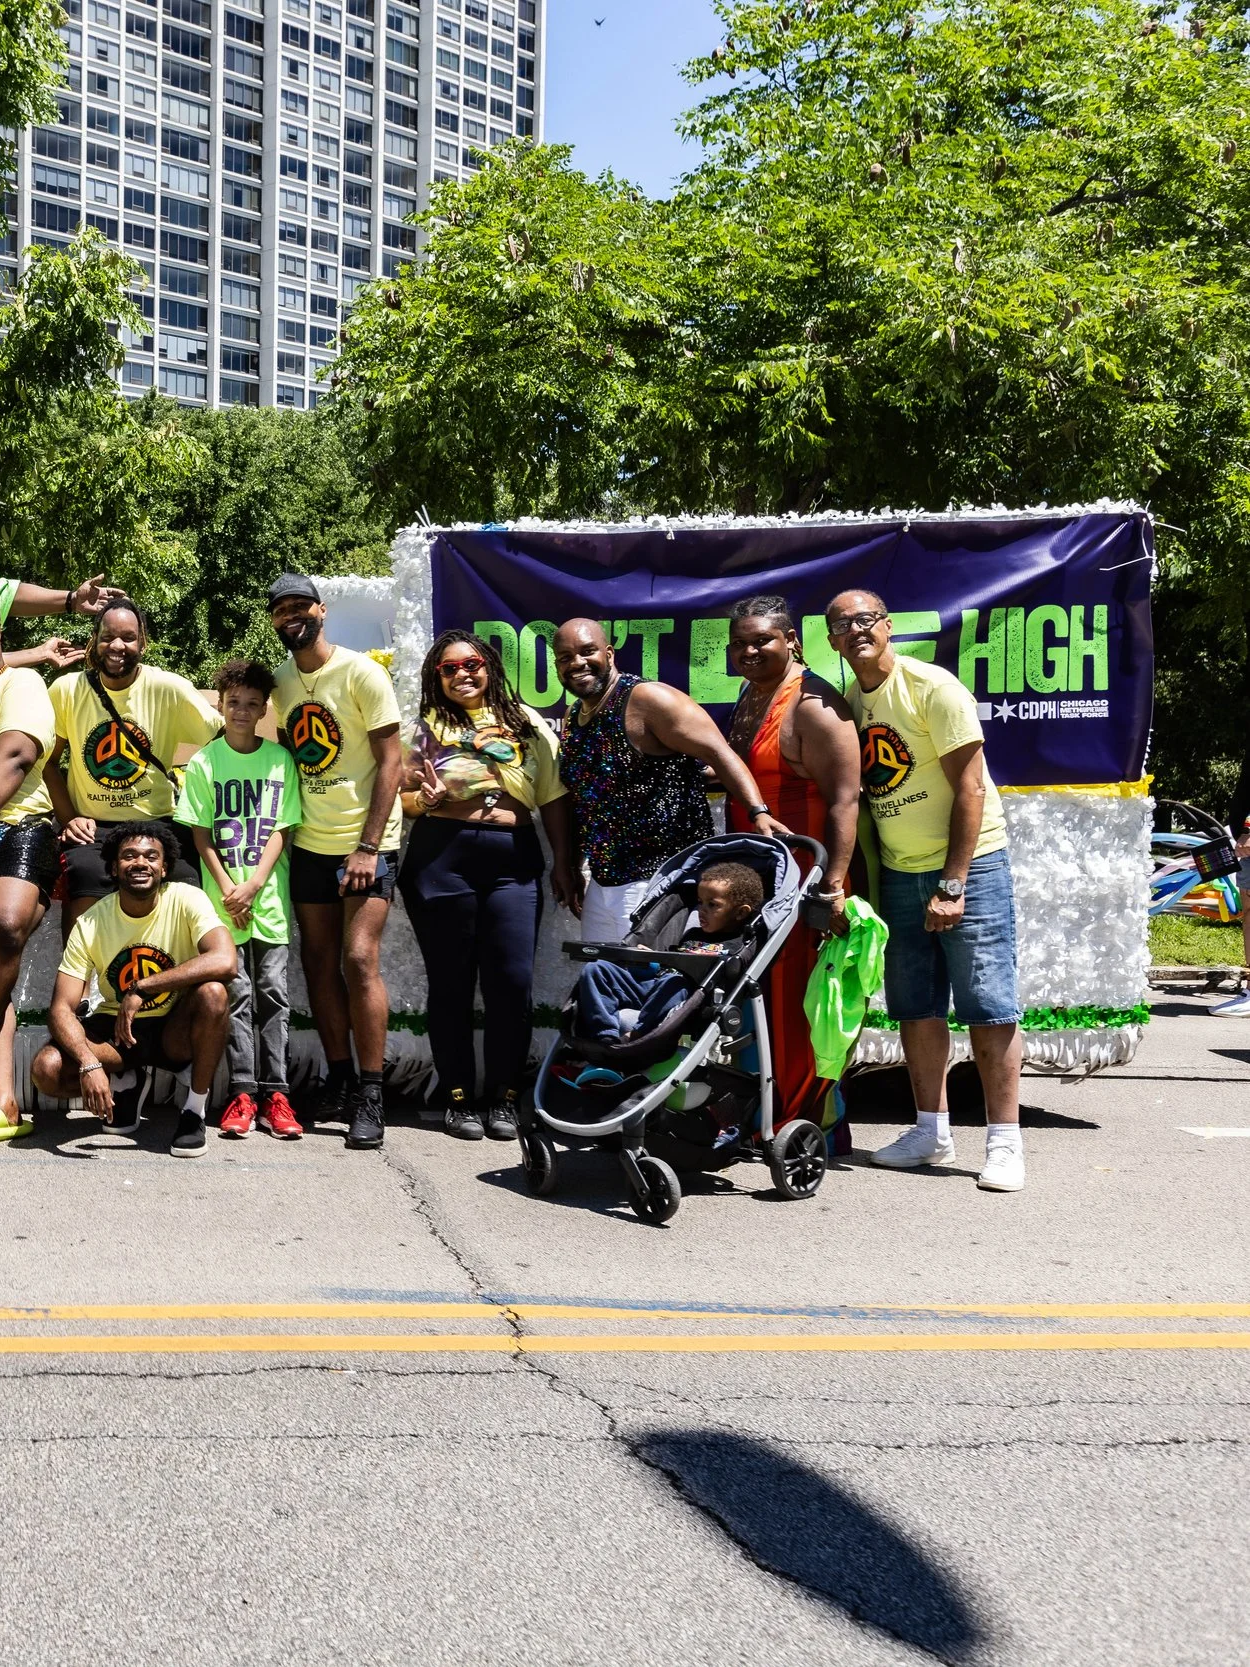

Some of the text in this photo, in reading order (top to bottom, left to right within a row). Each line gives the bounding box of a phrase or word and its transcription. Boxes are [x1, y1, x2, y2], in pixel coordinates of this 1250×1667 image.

[474, 618, 675, 708] DO'T
[958, 604, 1109, 694] HIGH
[1018, 701, 1057, 720] CDPH
[111, 793, 117, 801] &
[117, 789, 152, 801] WELLNESS
[214, 779, 285, 819] DON'T
[880, 790, 929, 811] WELLNESS
[214, 818, 277, 849] DIE
[220, 846, 263, 868] HIG
